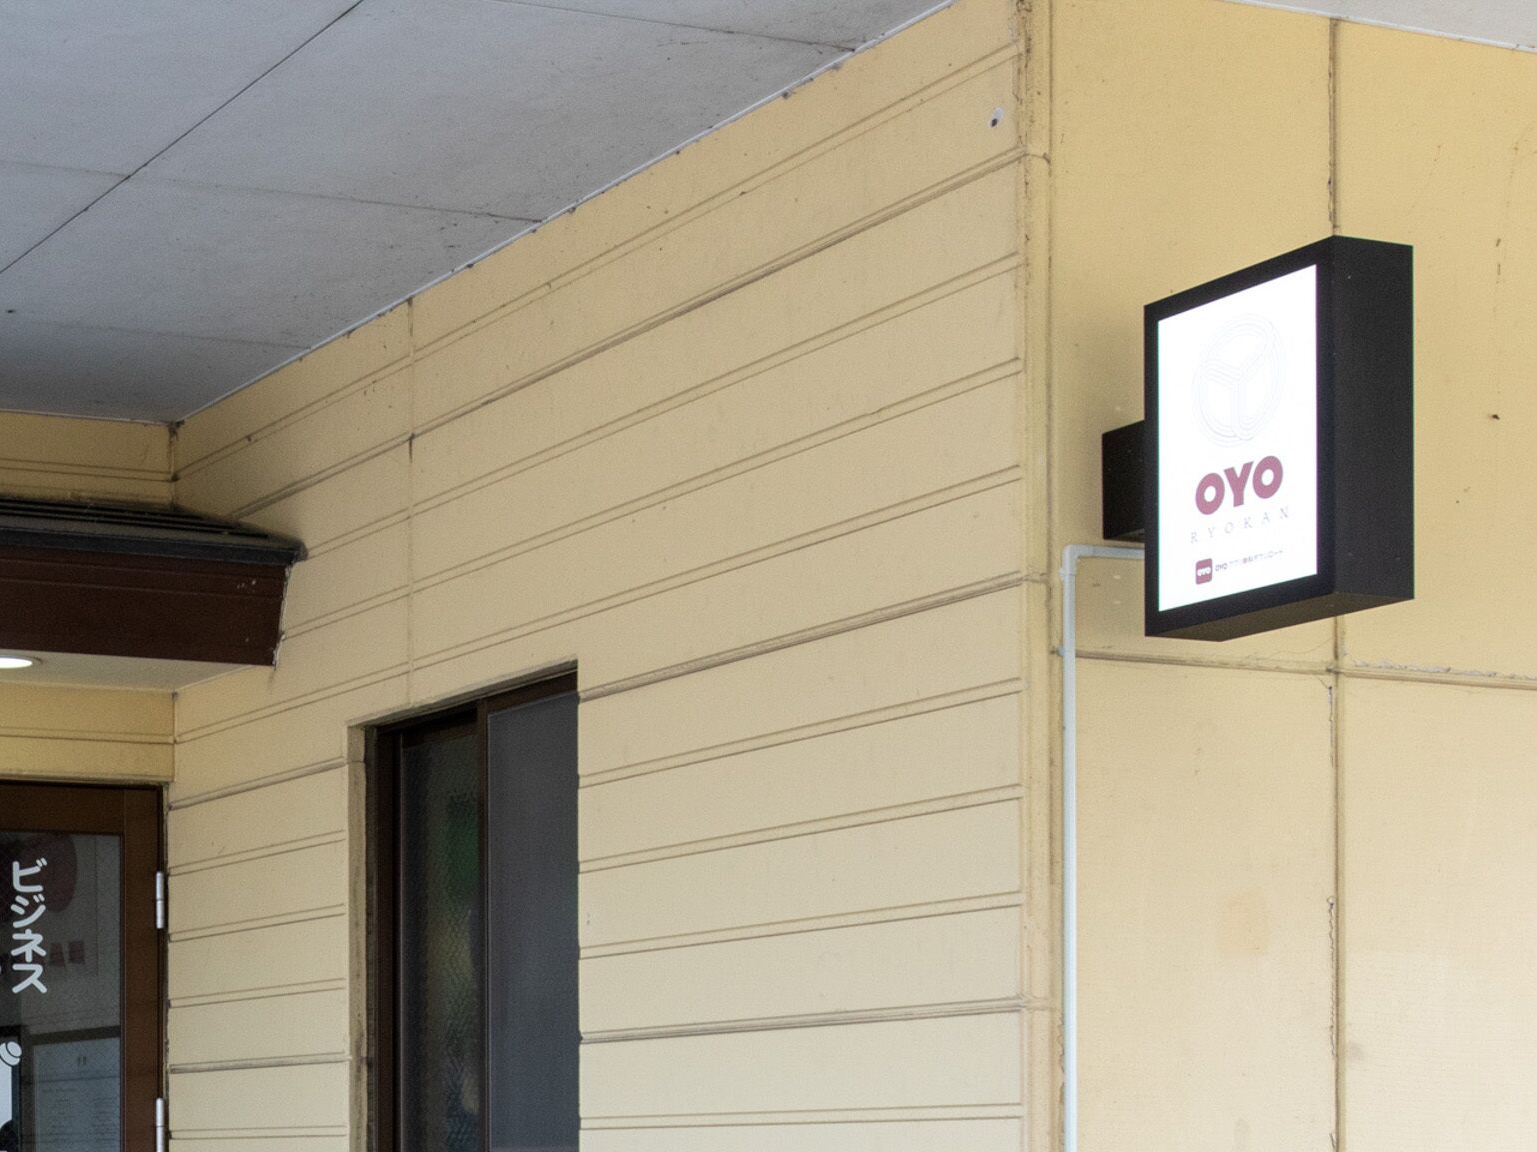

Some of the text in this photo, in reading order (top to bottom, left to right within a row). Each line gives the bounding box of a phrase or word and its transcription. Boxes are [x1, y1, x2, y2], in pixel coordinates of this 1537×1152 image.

[1195, 455, 1284, 516] OYO
[1190, 505, 1289, 544] RYOKAN
[10, 857, 47, 994] ビジネス
